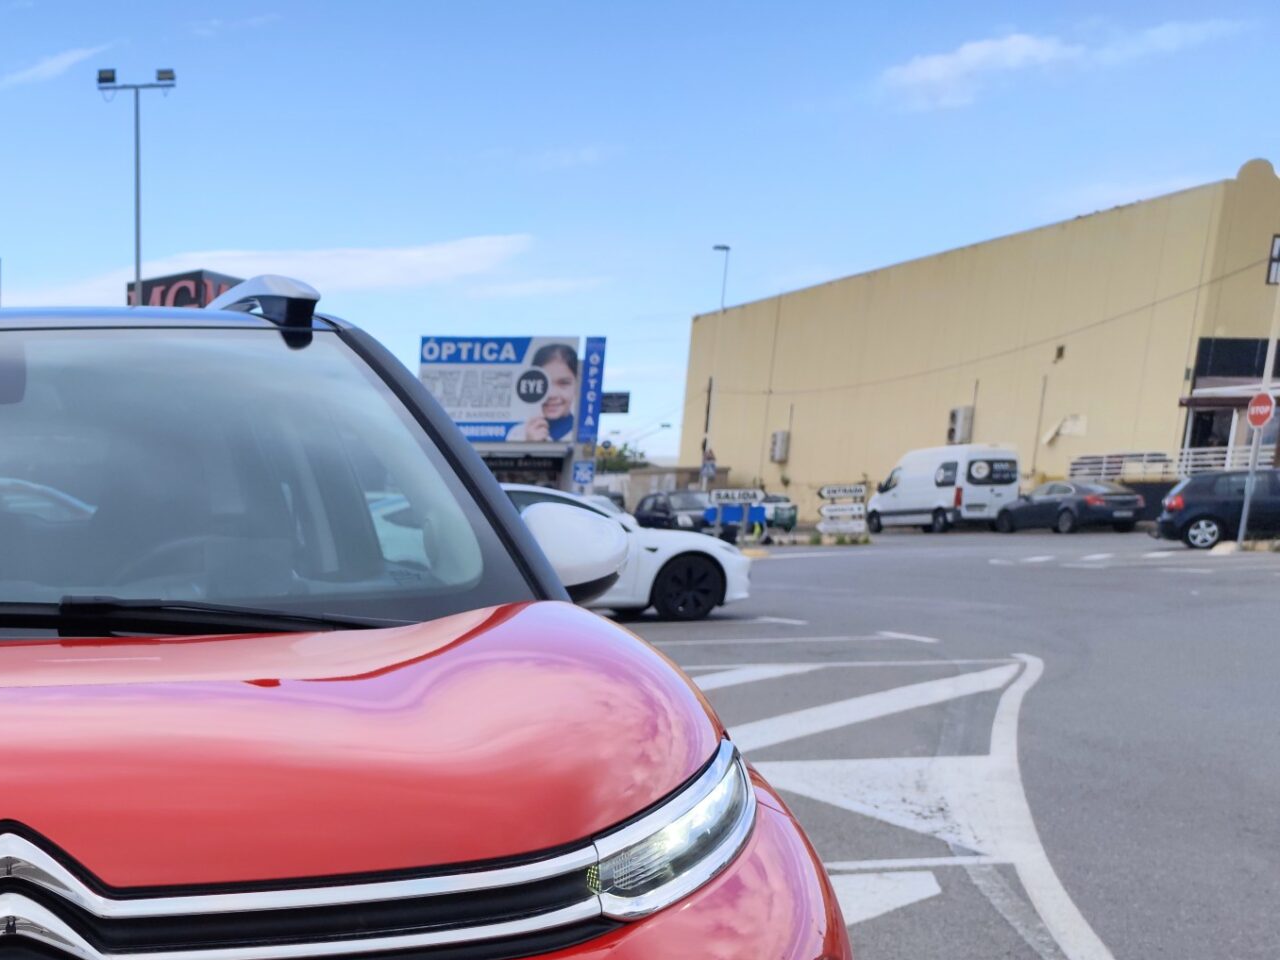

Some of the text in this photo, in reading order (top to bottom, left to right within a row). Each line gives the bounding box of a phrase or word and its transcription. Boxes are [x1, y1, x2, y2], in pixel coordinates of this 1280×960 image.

[422, 338, 517, 361] ÓPTICA
[519, 379, 545, 394] EYE
[1251, 405, 1270, 415] STOP
[715, 491, 758, 500] SALIDA
